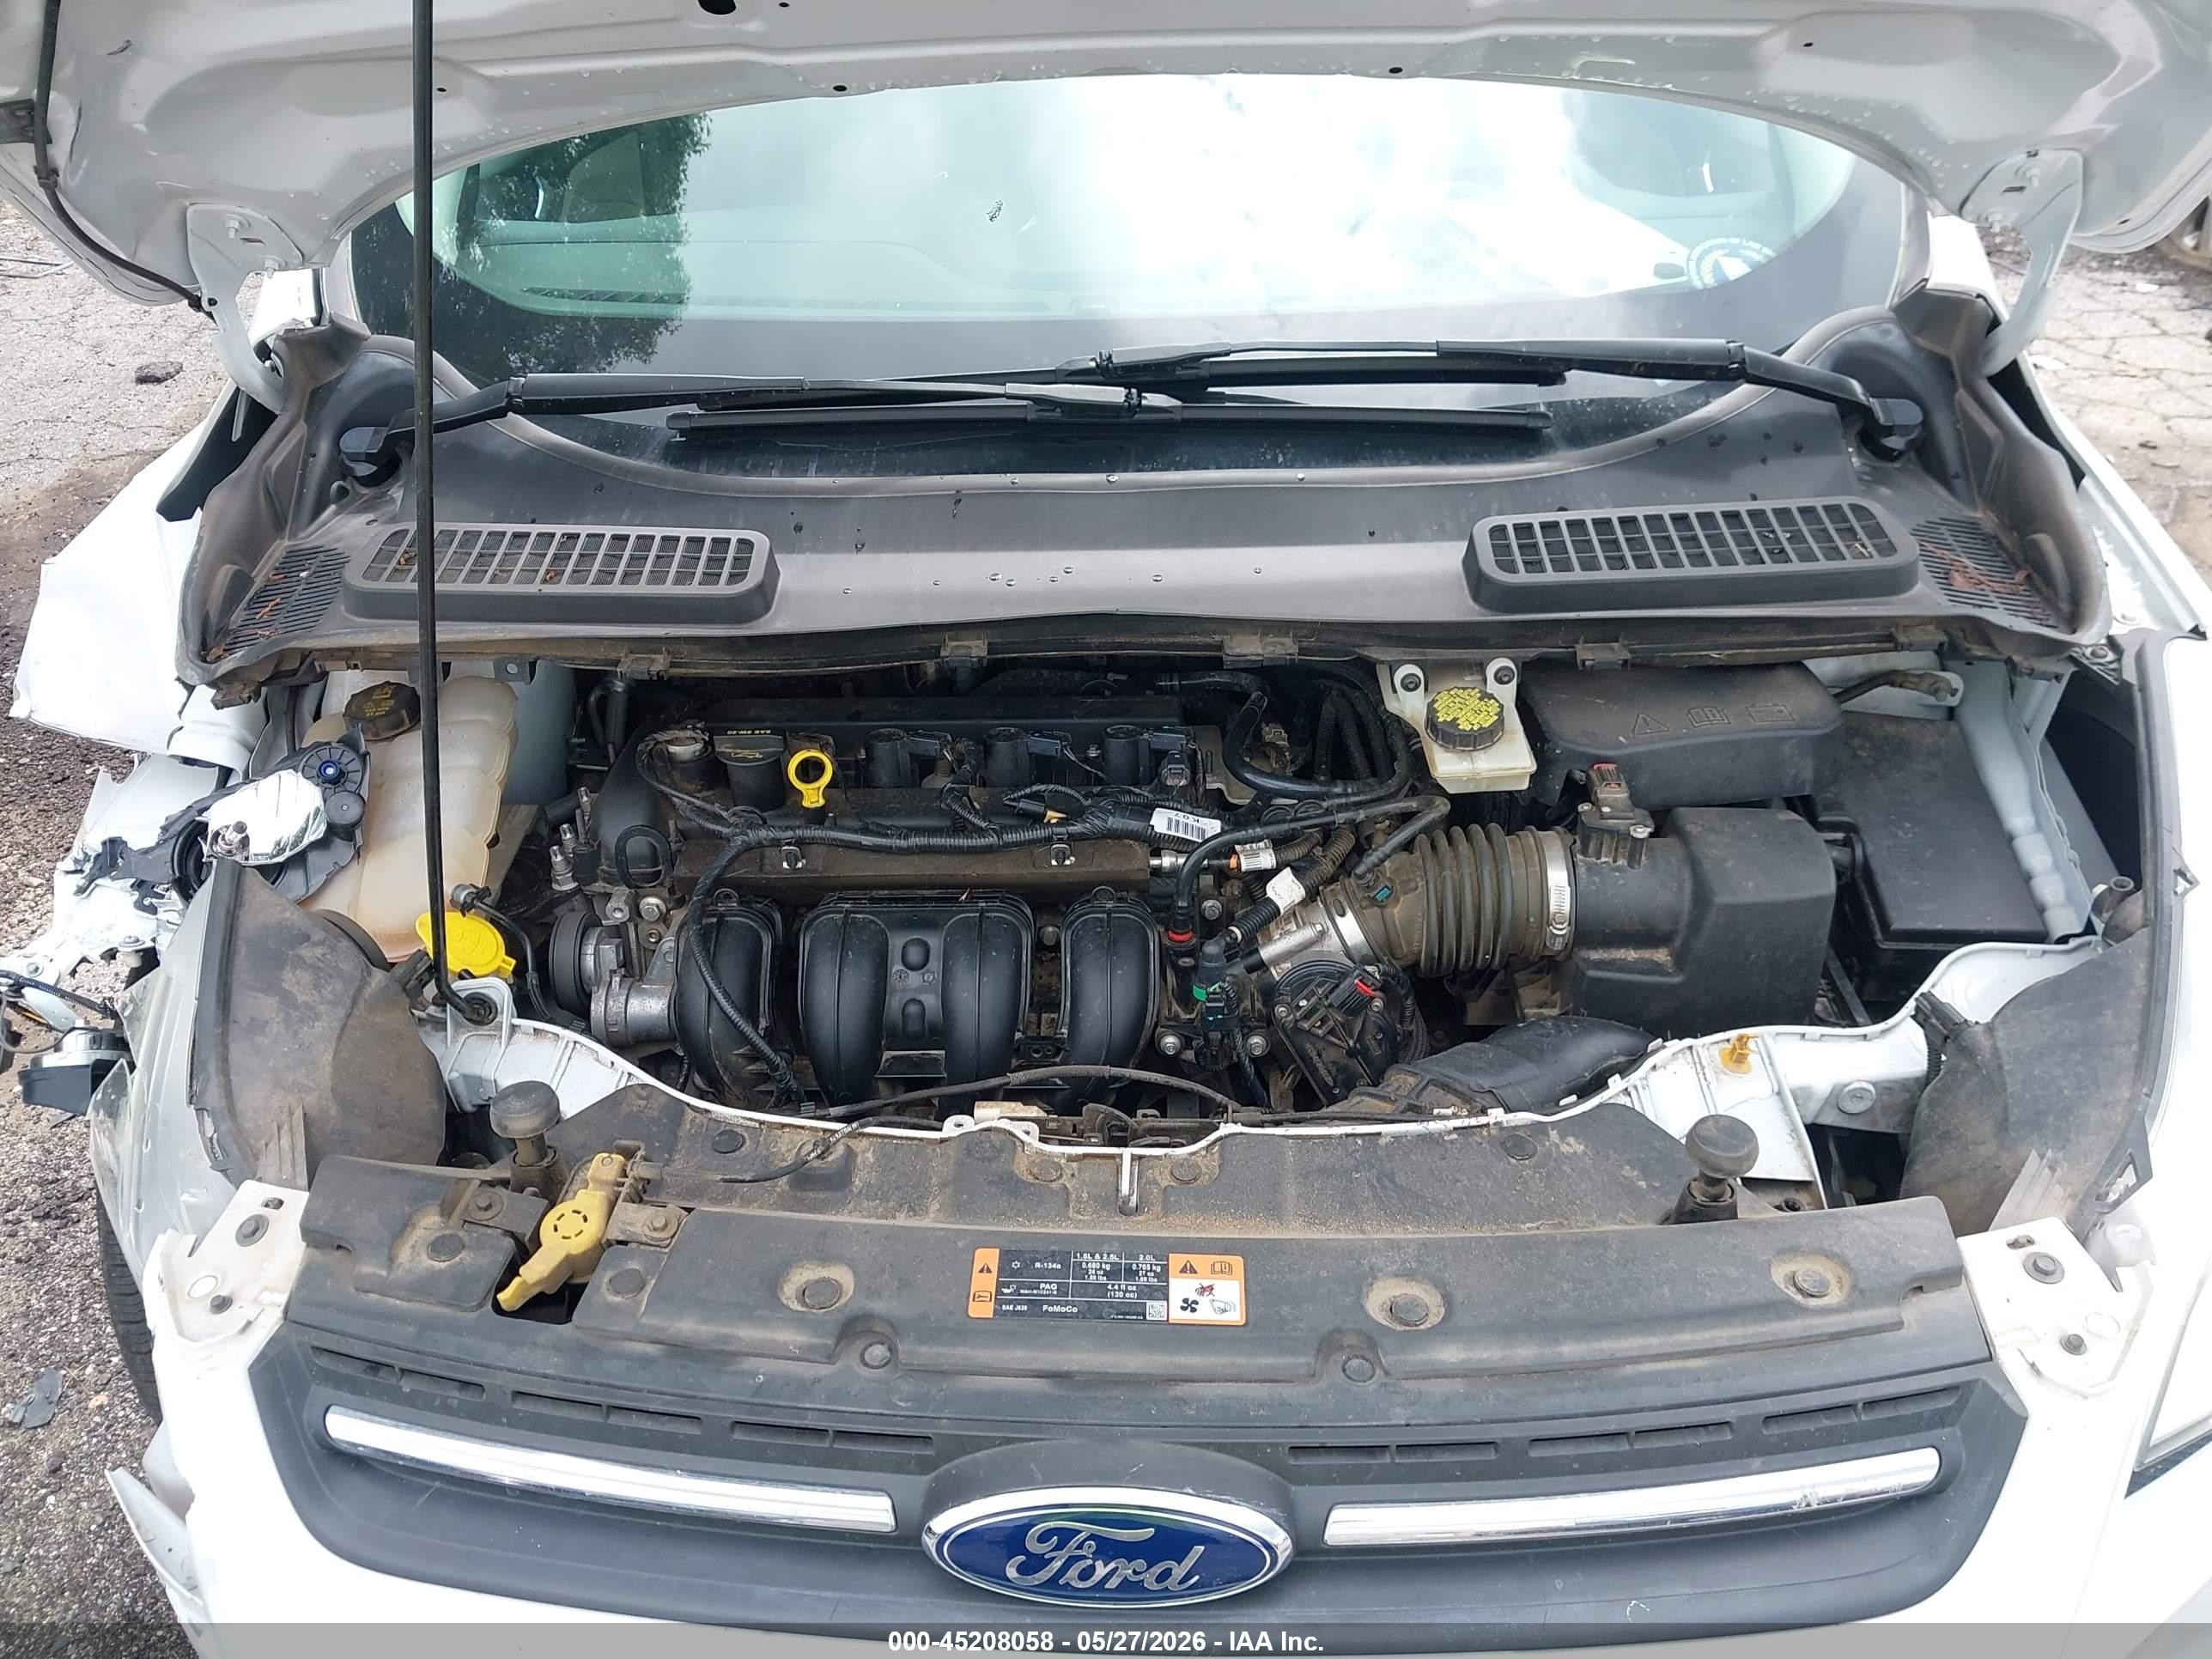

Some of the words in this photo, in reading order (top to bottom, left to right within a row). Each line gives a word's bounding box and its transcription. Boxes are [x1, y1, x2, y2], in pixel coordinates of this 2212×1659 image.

[1174, 812, 1200, 823] K07
[1034, 1261, 1061, 1270] R-134a
[1102, 1262, 1110, 1271] kg
[1152, 1264, 1161, 1273] kg
[1039, 1282, 1058, 1291] PAG
[1107, 1291, 1123, 1299] (130
[1125, 1291, 1138, 1299] cc)
[1042, 1304, 1079, 1313] FoMoCo
[1006, 1521, 1205, 1591] Ford
